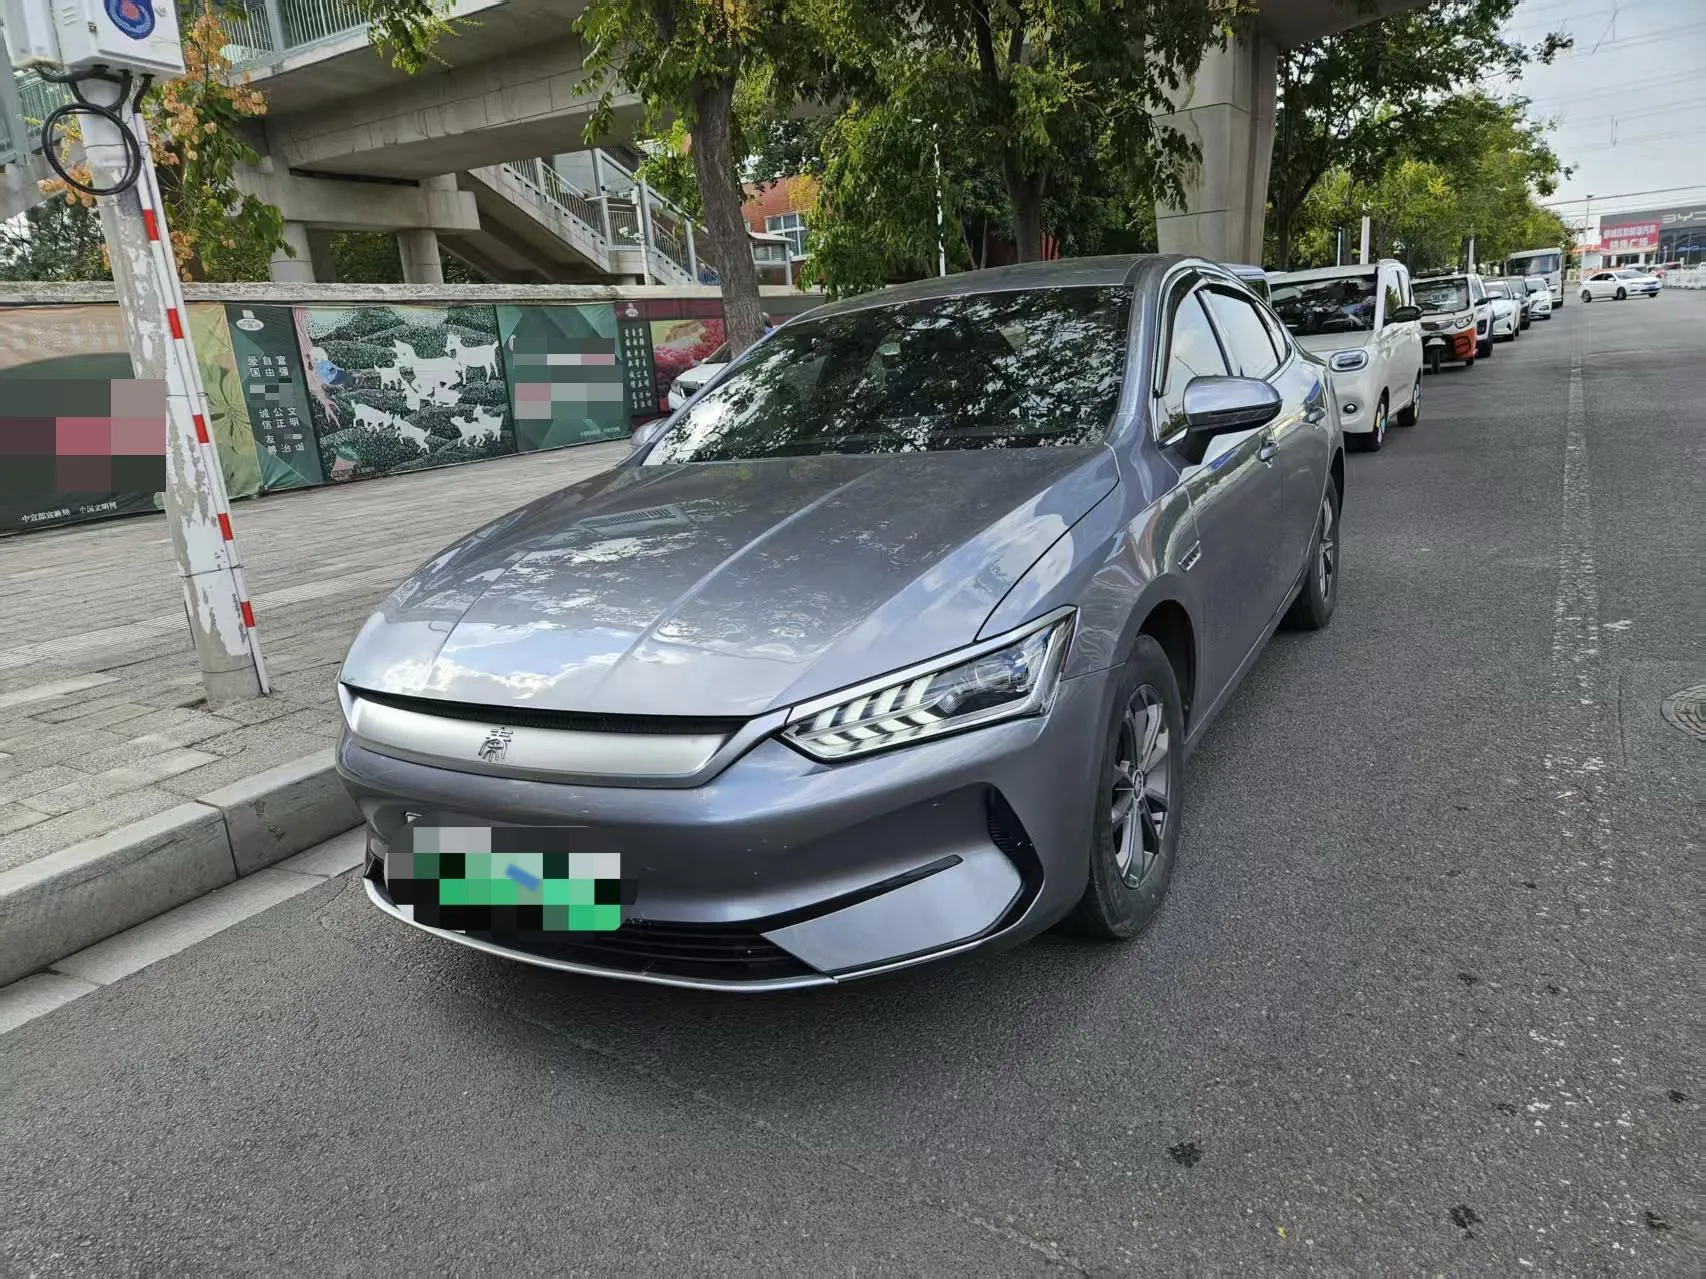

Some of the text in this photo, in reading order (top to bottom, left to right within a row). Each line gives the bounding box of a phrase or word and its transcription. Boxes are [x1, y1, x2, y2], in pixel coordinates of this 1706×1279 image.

[262, 356, 275, 376] 自由
[275, 355, 288, 376] 富强
[259, 408, 272, 430] 诚信
[273, 407, 286, 428] 公正
[287, 407, 300, 426] 文明
